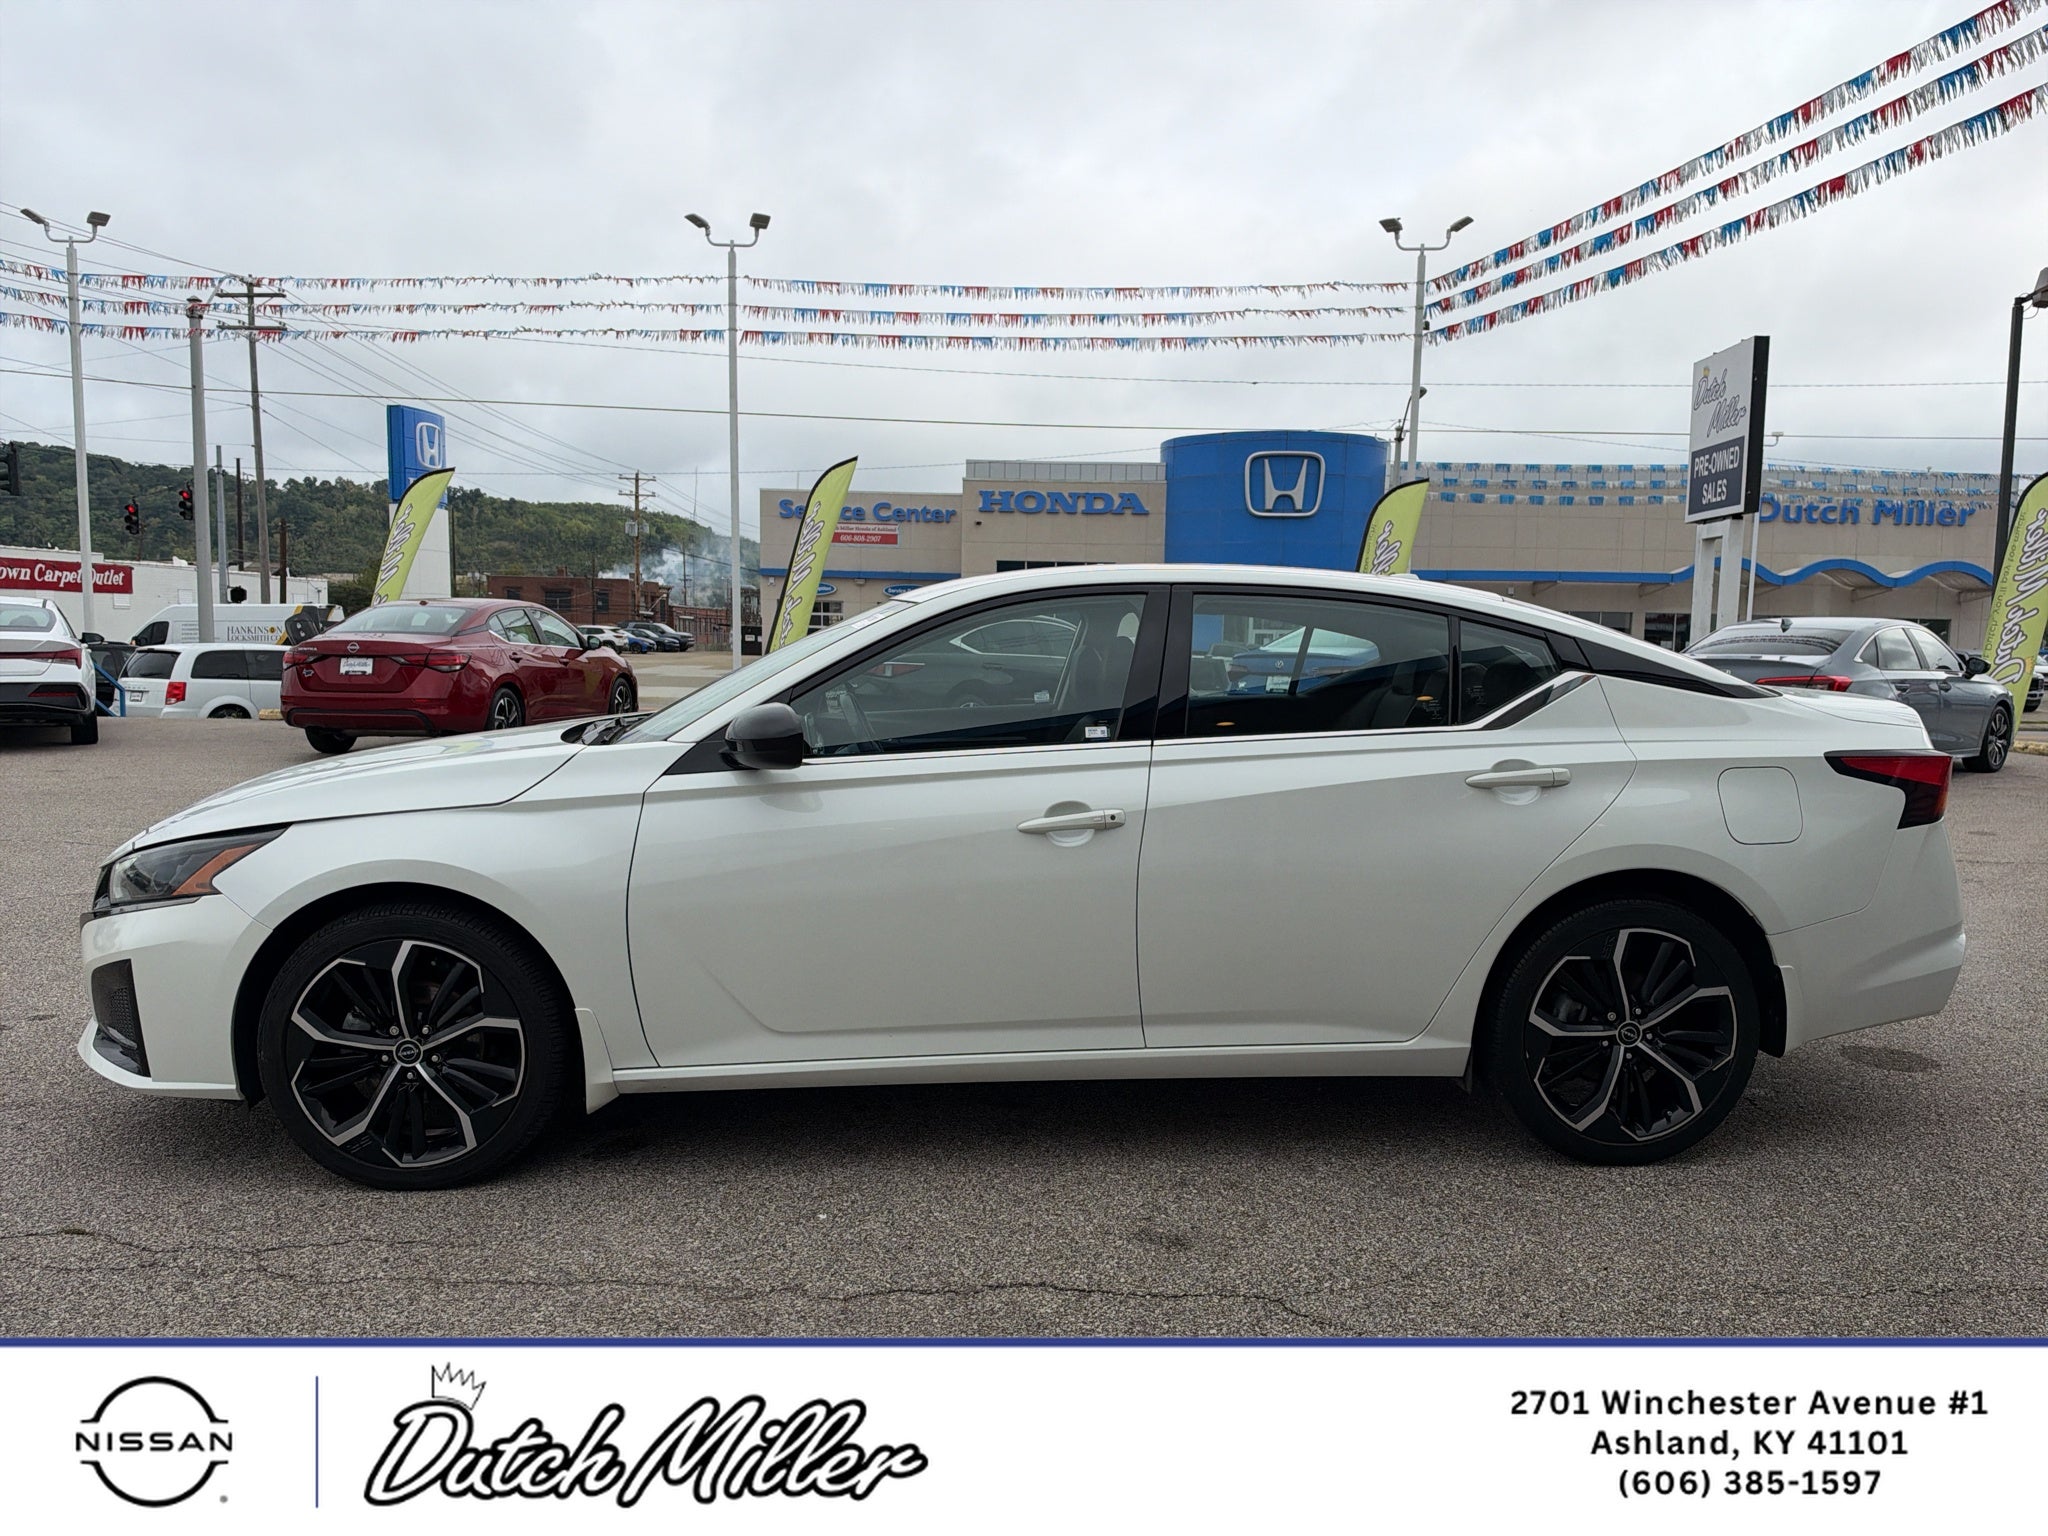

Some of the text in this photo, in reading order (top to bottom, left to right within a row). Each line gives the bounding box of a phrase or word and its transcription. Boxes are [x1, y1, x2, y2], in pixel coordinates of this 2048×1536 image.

[1693, 368, 1728, 412] Dutch
[1707, 395, 1747, 438] Miller
[1693, 445, 1740, 479] PRE-OWNED
[978, 490, 1149, 515] HONDA
[1702, 478, 1727, 505] SALES
[779, 499, 957, 523] Sece Center
[1760, 499, 1977, 527] Dutch Miller
[34, 563, 82, 587] Carpet
